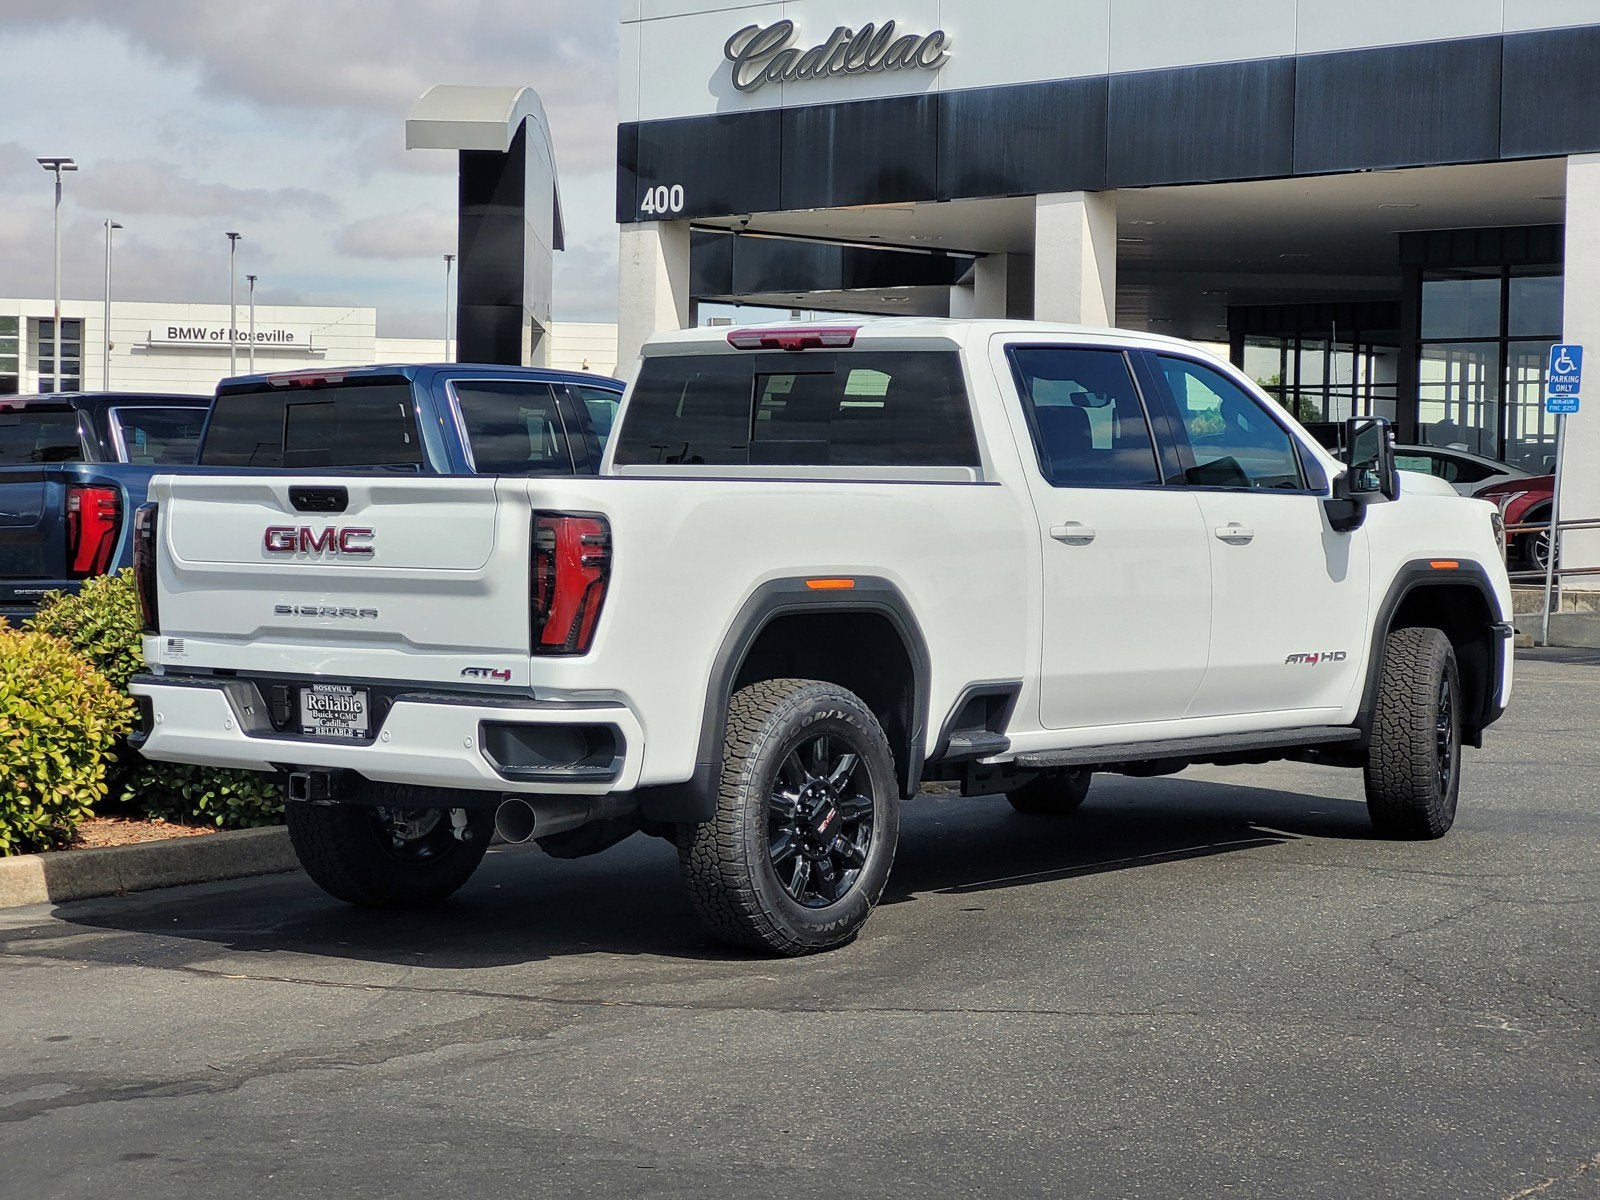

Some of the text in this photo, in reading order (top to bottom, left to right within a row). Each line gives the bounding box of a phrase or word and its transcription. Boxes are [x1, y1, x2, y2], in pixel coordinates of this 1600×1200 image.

[724, 19, 950, 92] Cadillac
[641, 184, 684, 214] 400
[167, 326, 207, 340] BMW
[210, 328, 225, 340] of
[1551, 375, 1579, 383] PARKING
[1556, 384, 1573, 392] ONLY
[264, 525, 375, 556] GMC
[274, 604, 378, 619] SIERRA
[1285, 651, 1347, 667] AT4 HD
[461, 666, 511, 682] AT4
[313, 684, 352, 693] ROSEVILLE
[307, 694, 363, 713] Reliable
[313, 710, 333, 718] Buick
[319, 718, 350, 728] Cadillac
[315, 727, 354, 737] RELIABLE
